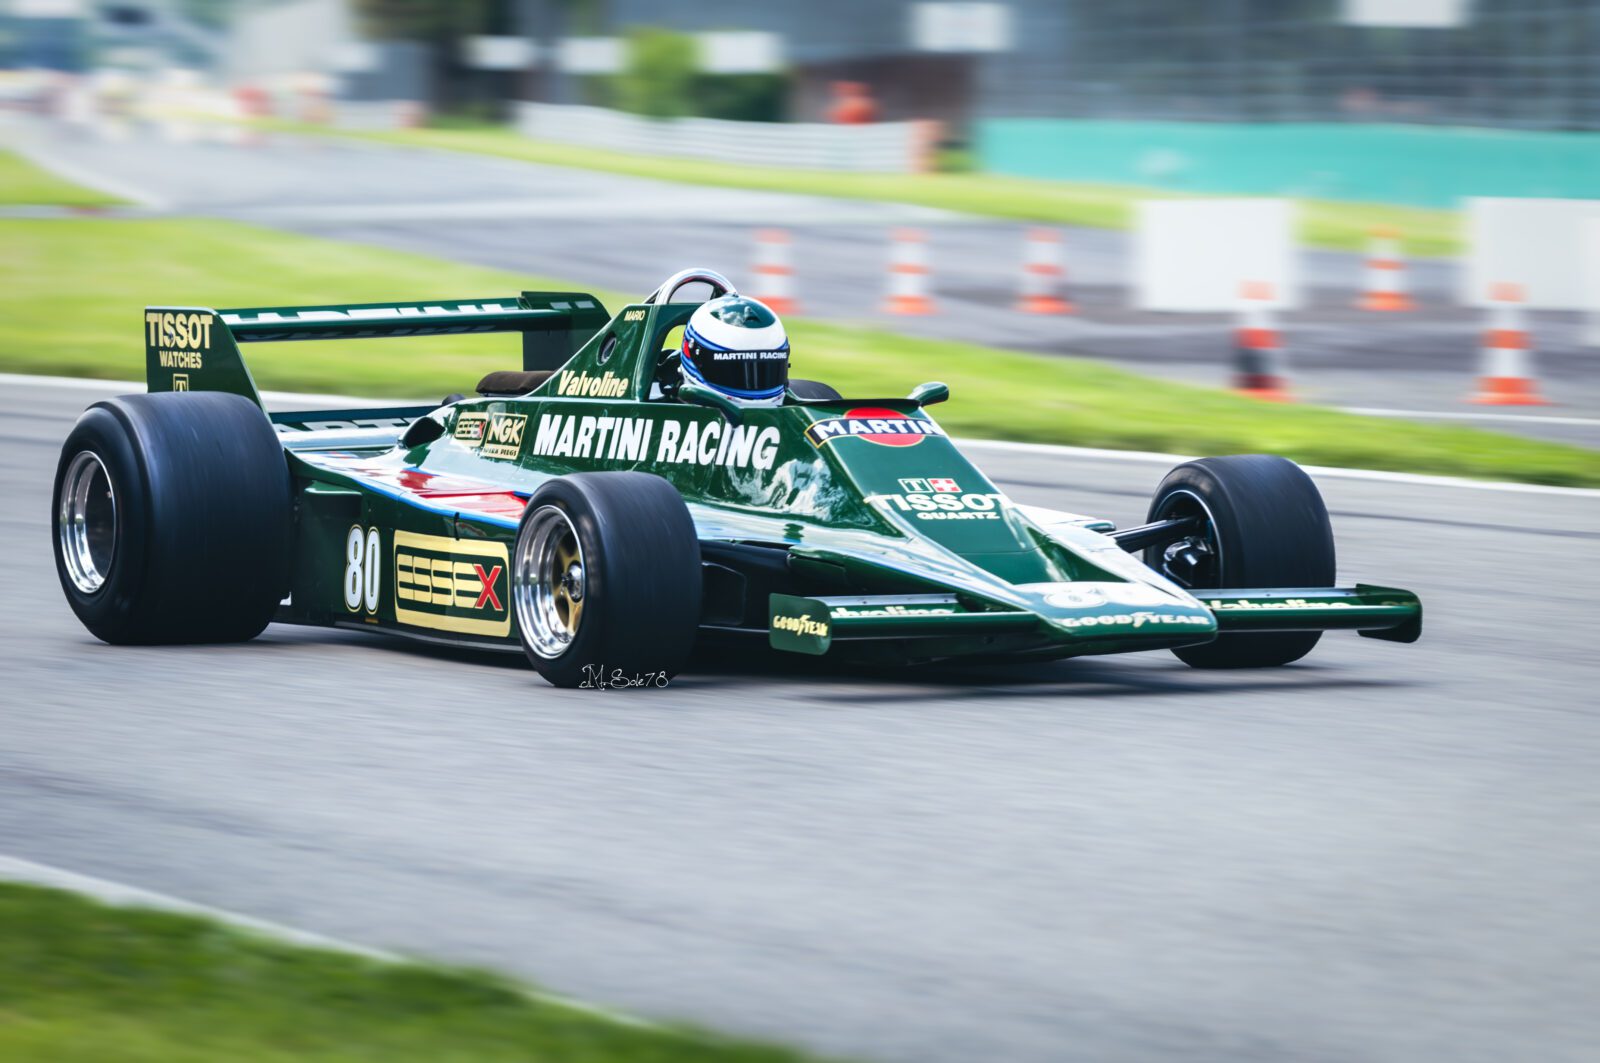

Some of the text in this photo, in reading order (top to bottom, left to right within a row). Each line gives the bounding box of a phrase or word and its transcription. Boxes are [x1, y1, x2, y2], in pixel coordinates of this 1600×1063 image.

[624, 310, 646, 321] MARIO
[146, 313, 213, 349] TISSOT
[159, 351, 202, 369] WATCHES
[714, 352, 757, 361] MARTINI
[557, 370, 629, 398] Valvoline
[488, 418, 524, 445] NGK
[812, 419, 945, 440] MARTIN
[533, 414, 781, 470] MARTINI RACING
[916, 512, 1000, 520] QUARTZ
[344, 524, 381, 615] 80
[397, 553, 503, 612] ESSEX
[1062, 612, 1211, 628] GOODYEAR
